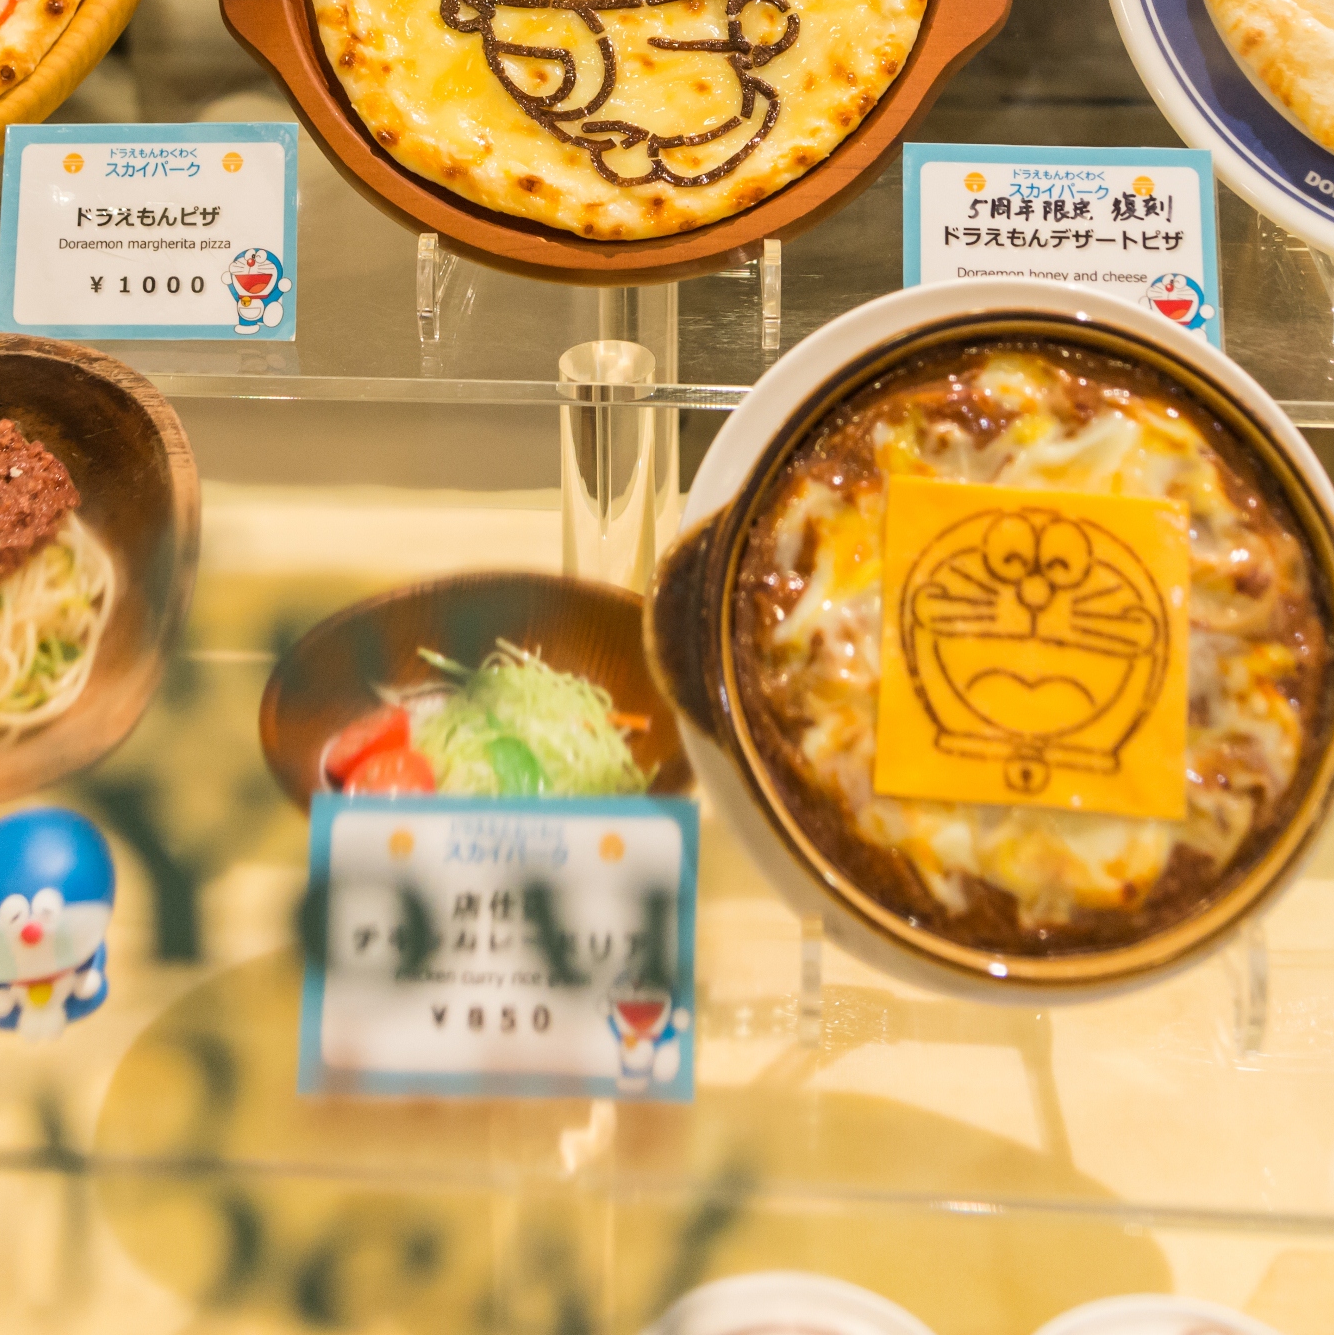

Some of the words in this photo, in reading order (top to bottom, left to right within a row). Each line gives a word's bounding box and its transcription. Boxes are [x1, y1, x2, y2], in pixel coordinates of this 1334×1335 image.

[110, 147, 198, 159] ドラえもんわくわく
[105, 161, 201, 178] スカイパーク
[1012, 168, 1105, 181] ドラえもんわくわく
[1008, 182, 1109, 200] スカイパーク
[76, 206, 221, 227] ドラえもんピザ
[59, 238, 123, 250] Doraemon
[128, 238, 195, 253] margherita
[200, 238, 231, 251] pizza
[943, 225, 1184, 251] ドラえもんデザートピザ
[1073, 271, 1098, 282] and
[1102, 271, 1148, 283] cheese
